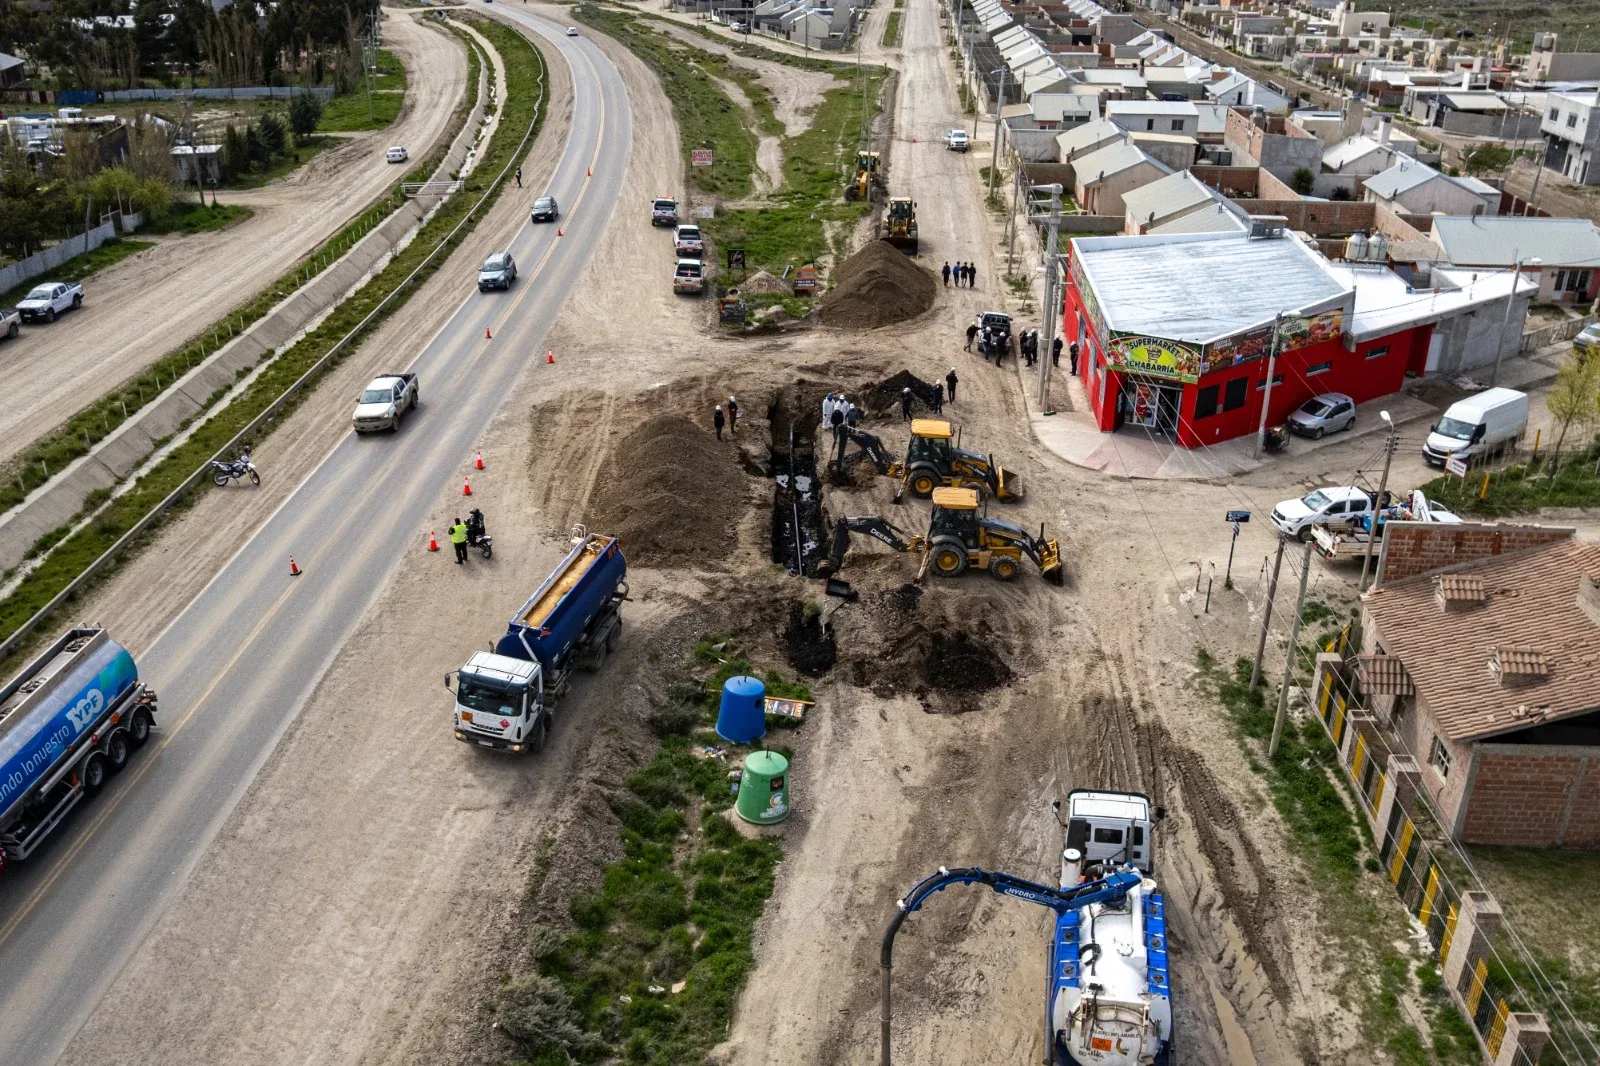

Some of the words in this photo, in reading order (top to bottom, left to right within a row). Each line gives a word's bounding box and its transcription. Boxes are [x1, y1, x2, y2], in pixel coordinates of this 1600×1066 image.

[1129, 338, 1180, 357] SUPERMARKET
[867, 447, 878, 463] DEERE
[870, 527, 893, 544] DEERE
[21, 761, 35, 776] lo
[32, 725, 70, 767] nuestro
[69, 690, 102, 728] YPF
